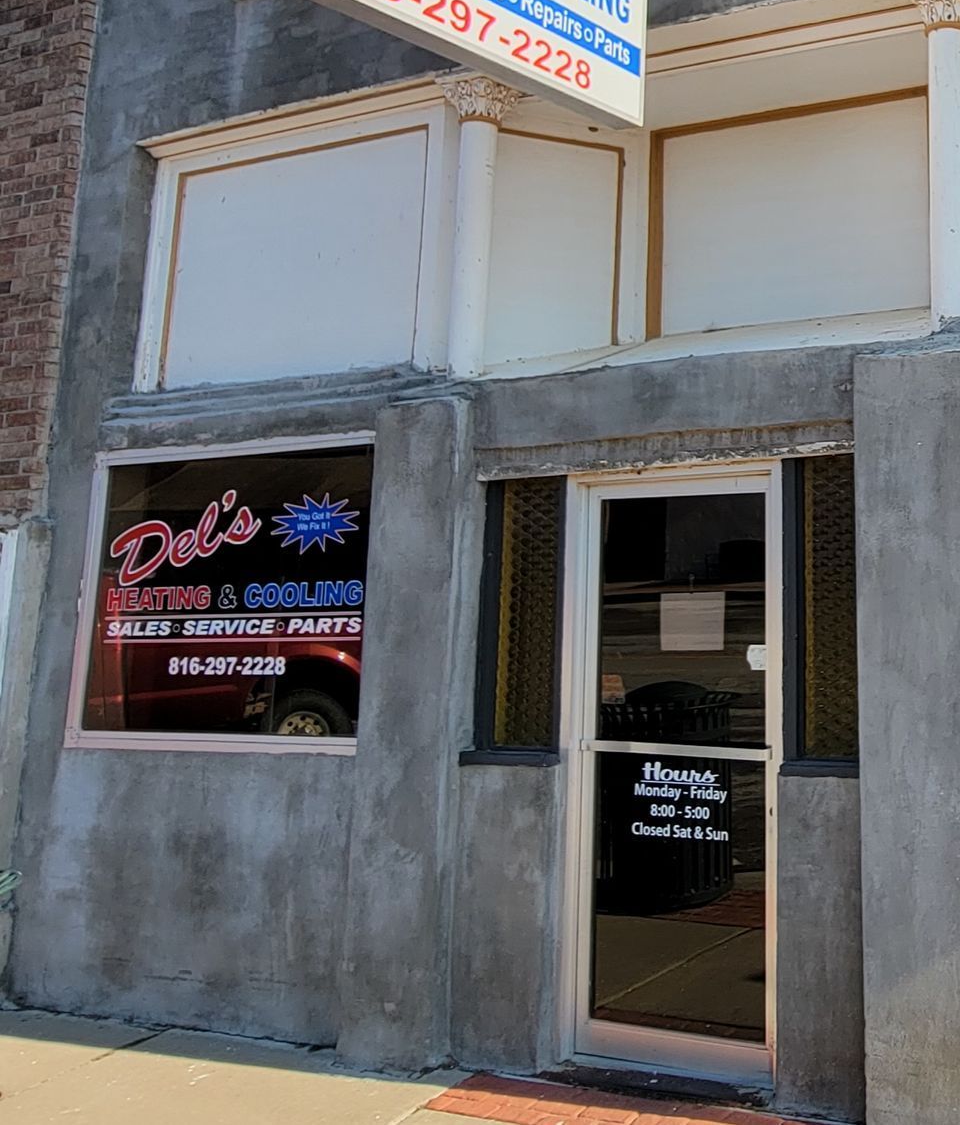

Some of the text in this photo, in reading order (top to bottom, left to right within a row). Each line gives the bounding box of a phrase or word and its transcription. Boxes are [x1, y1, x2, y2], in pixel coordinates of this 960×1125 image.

[594, 28, 631, 65] Parts
[298, 513, 310, 521] You
[312, 512, 324, 520] Got
[310, 522, 320, 530] Fix
[110, 490, 261, 586] Del's
[106, 580, 363, 611] HEATING & COOLING
[106, 617, 362, 636] SALES SERVICE PARTS
[168, 656, 286, 675] 816-297-2228
[641, 761, 719, 783] Hours
[634, 783, 681, 801] Monday
[690, 786, 727, 804] Friday
[650, 804, 675, 817] 8:00
[684, 805, 710, 819] 5:00
[631, 822, 729, 841] Closed Sat & Sun
